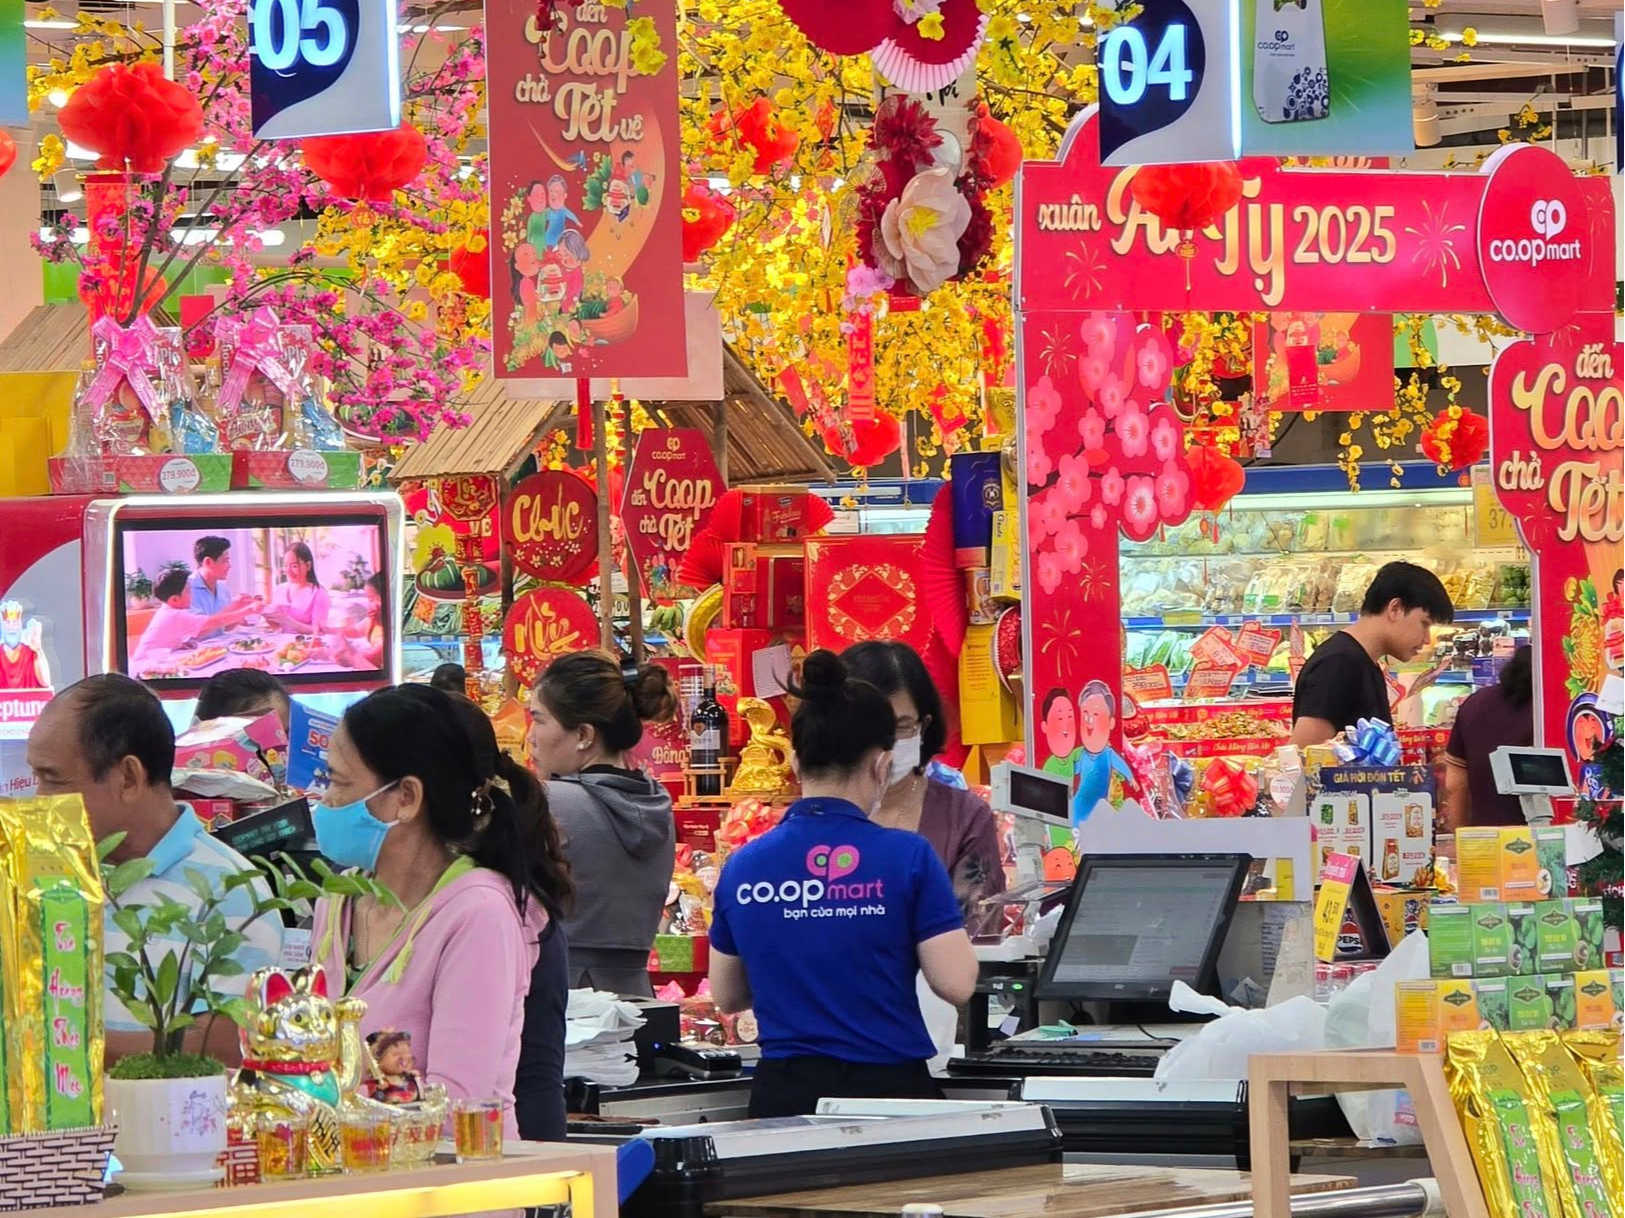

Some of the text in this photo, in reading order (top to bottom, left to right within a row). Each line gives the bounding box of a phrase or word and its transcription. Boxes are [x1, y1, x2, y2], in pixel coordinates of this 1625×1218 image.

[254, 0, 346, 70] 05
[1103, 23, 1193, 106] 04
[554, 82, 619, 142] Tết
[1037, 194, 1102, 231] xuân
[1293, 205, 1397, 264] 2025
[1575, 342, 1614, 379] đến
[659, 513, 695, 551] Tết
[783, 904, 886, 920] bạn của mọi nhà
[1338, 935, 1360, 945] PEPS
